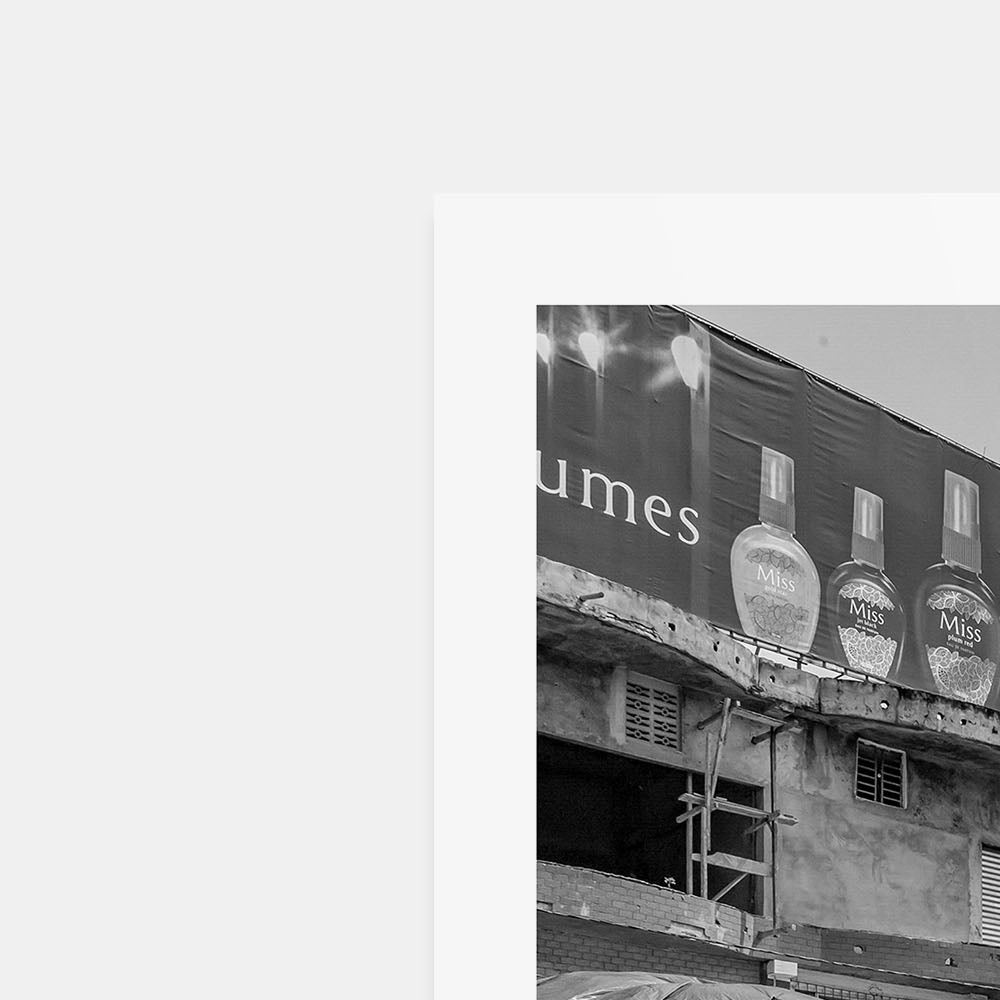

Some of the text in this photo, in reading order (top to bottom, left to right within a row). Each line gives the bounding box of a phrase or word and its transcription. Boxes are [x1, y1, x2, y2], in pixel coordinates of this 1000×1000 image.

[537, 450, 700, 545] umes
[757, 564, 795, 592] Miss
[849, 599, 885, 625] Miss
[940, 610, 982, 643] Miss
